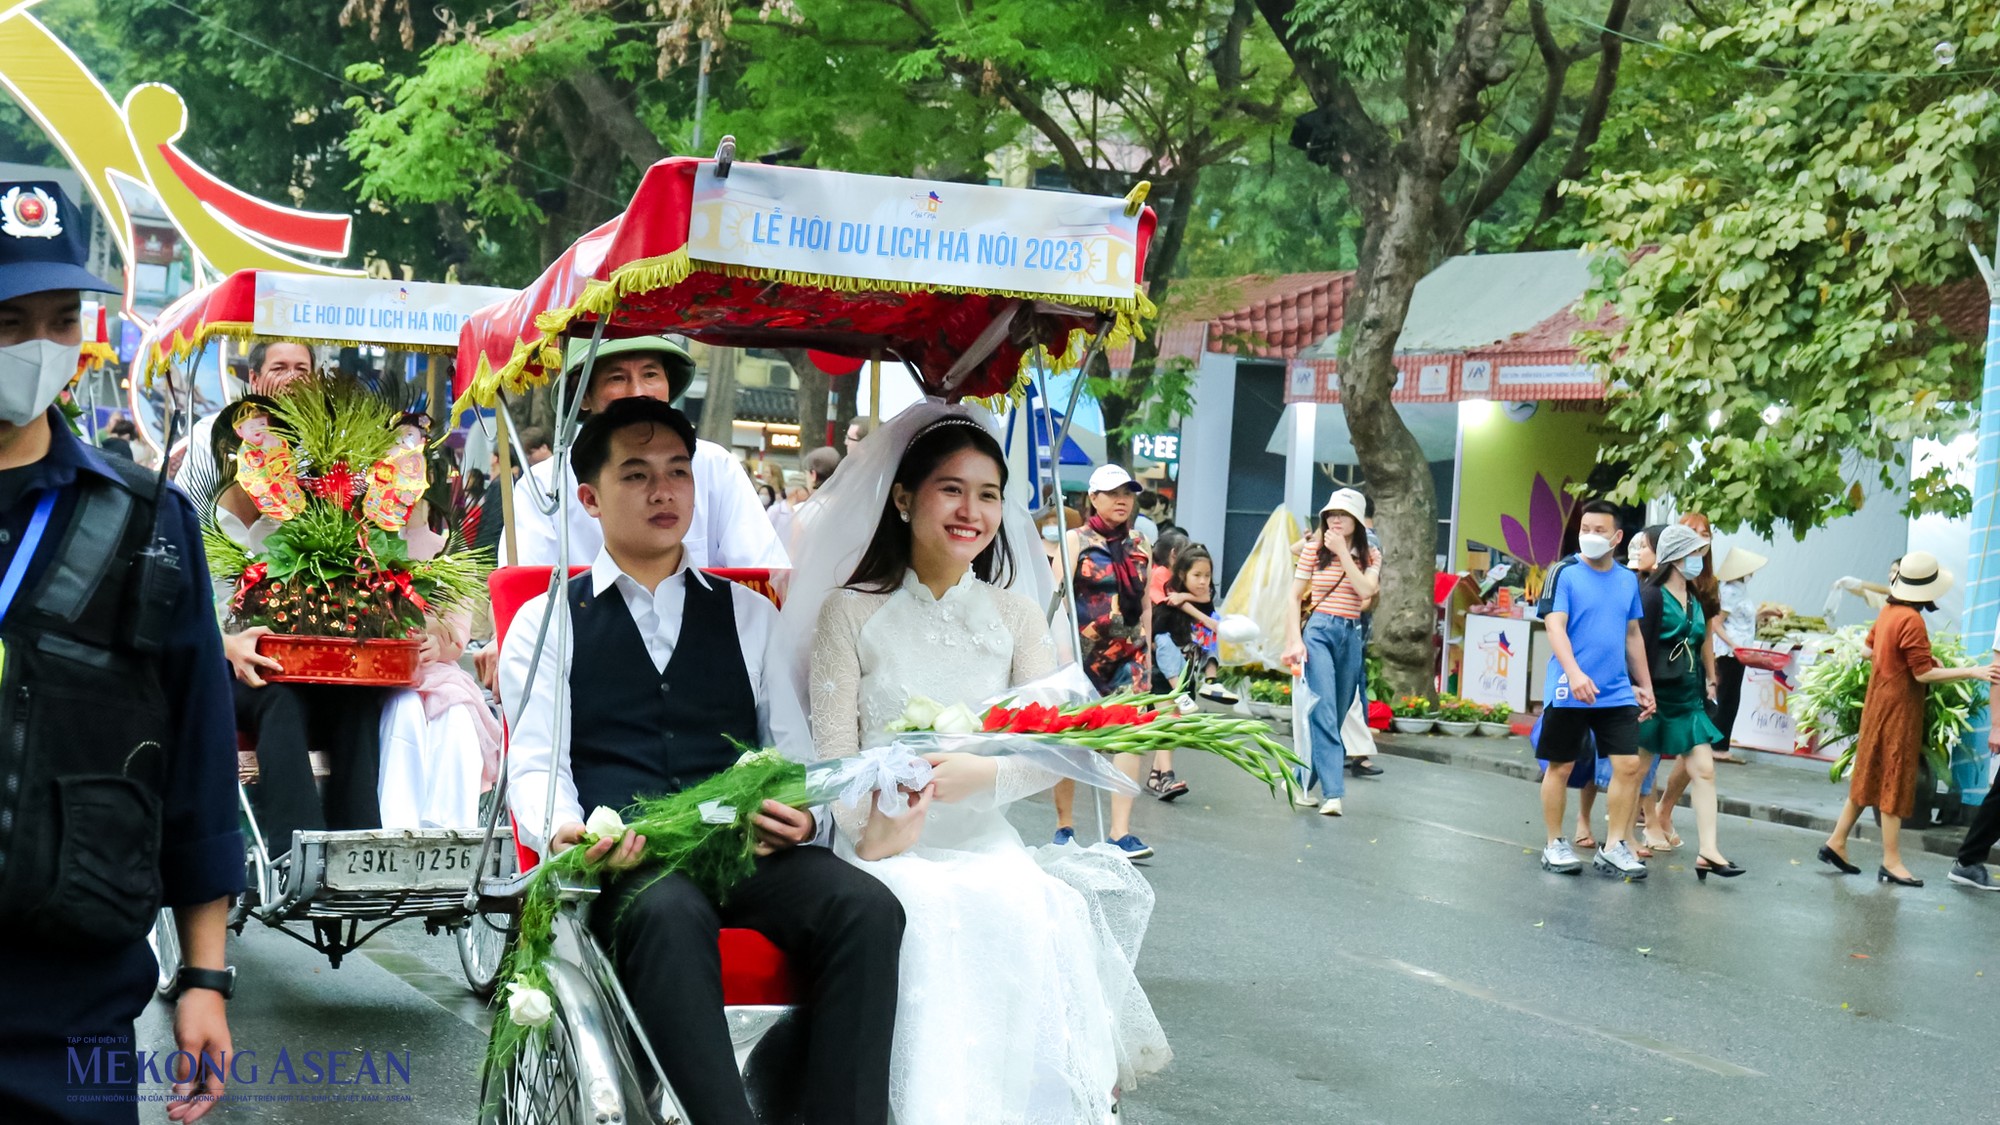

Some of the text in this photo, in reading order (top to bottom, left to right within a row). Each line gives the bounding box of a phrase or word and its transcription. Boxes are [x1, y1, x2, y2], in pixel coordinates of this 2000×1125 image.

[752, 206, 783, 245] LỄ
[788, 214, 832, 253] HỘI
[838, 221, 871, 254] DU
[976, 231, 1018, 270] NỘI
[1023, 238, 1083, 273] 2023
[345, 307, 366, 326] DU
